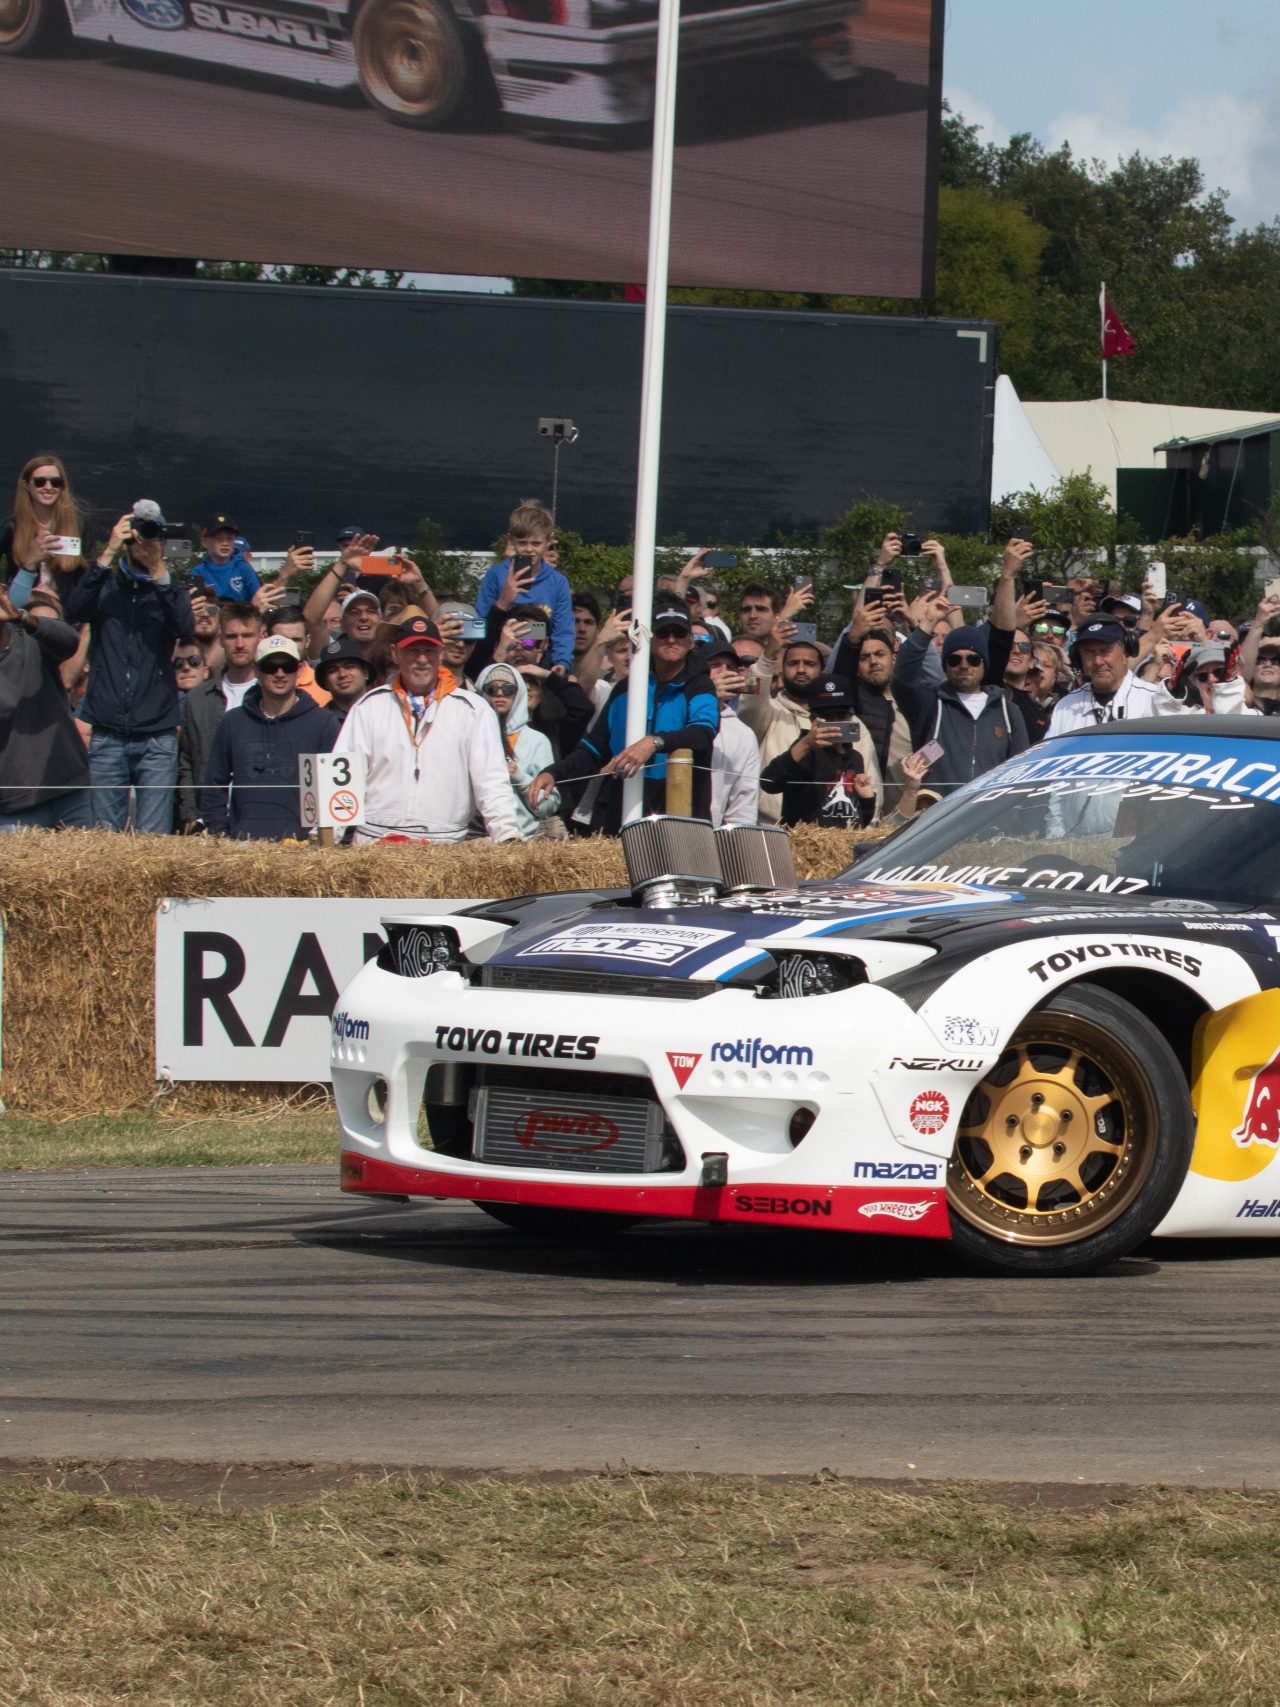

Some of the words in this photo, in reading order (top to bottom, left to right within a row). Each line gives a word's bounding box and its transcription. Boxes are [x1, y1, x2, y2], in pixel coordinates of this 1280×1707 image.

[189, 2, 330, 50] SUBARU
[304, 758, 312, 787] 3
[333, 757, 351, 786] 3
[398, 928, 433, 978] KC
[1027, 944, 1112, 983] TOYO
[1110, 943, 1202, 978] TIRES
[780, 954, 817, 998] KC
[436, 1025, 501, 1055] TOYO
[507, 1032, 600, 1061] TIRES
[711, 1037, 813, 1069] rotiform
[672, 1055, 696, 1068] TOW
[915, 1100, 945, 1112] NGK
[735, 1195, 832, 1216] SEBON
